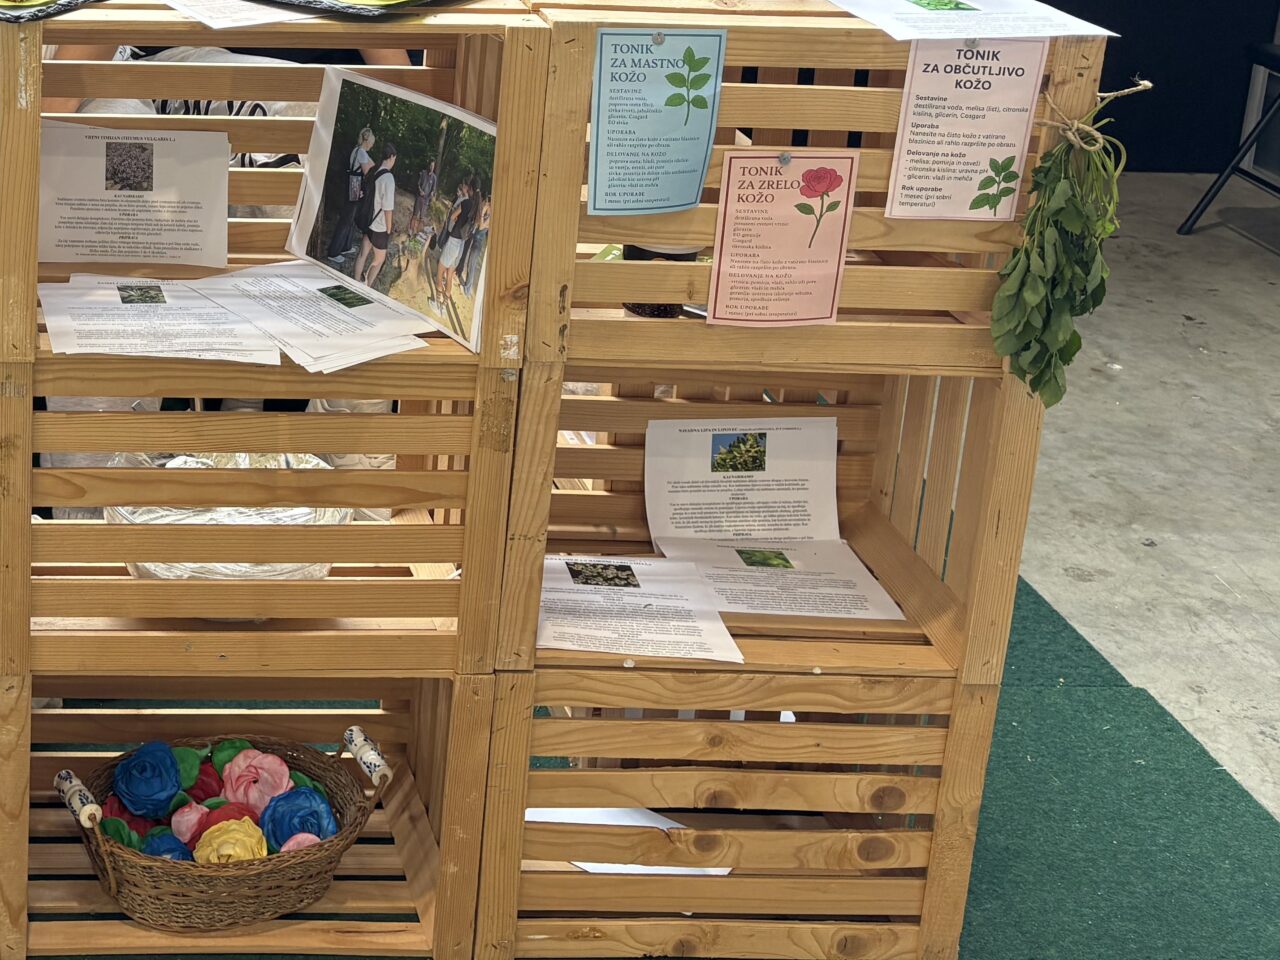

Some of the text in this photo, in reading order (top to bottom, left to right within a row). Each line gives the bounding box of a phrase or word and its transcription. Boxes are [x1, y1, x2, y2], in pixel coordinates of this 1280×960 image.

[611, 43, 654, 54] TONIK
[956, 49, 1001, 62] TONIK
[610, 58, 685, 69] ZA MASTNO
[922, 63, 1025, 77] ZA OBČUTLJIVO
[610, 71, 647, 82] KOŽO
[954, 78, 992, 90] KOŽO
[907, 150, 939, 158] Delovanje
[740, 166, 784, 176] TONIK
[738, 180, 800, 190] ZA ZRELO
[737, 193, 775, 203] KOŽO
